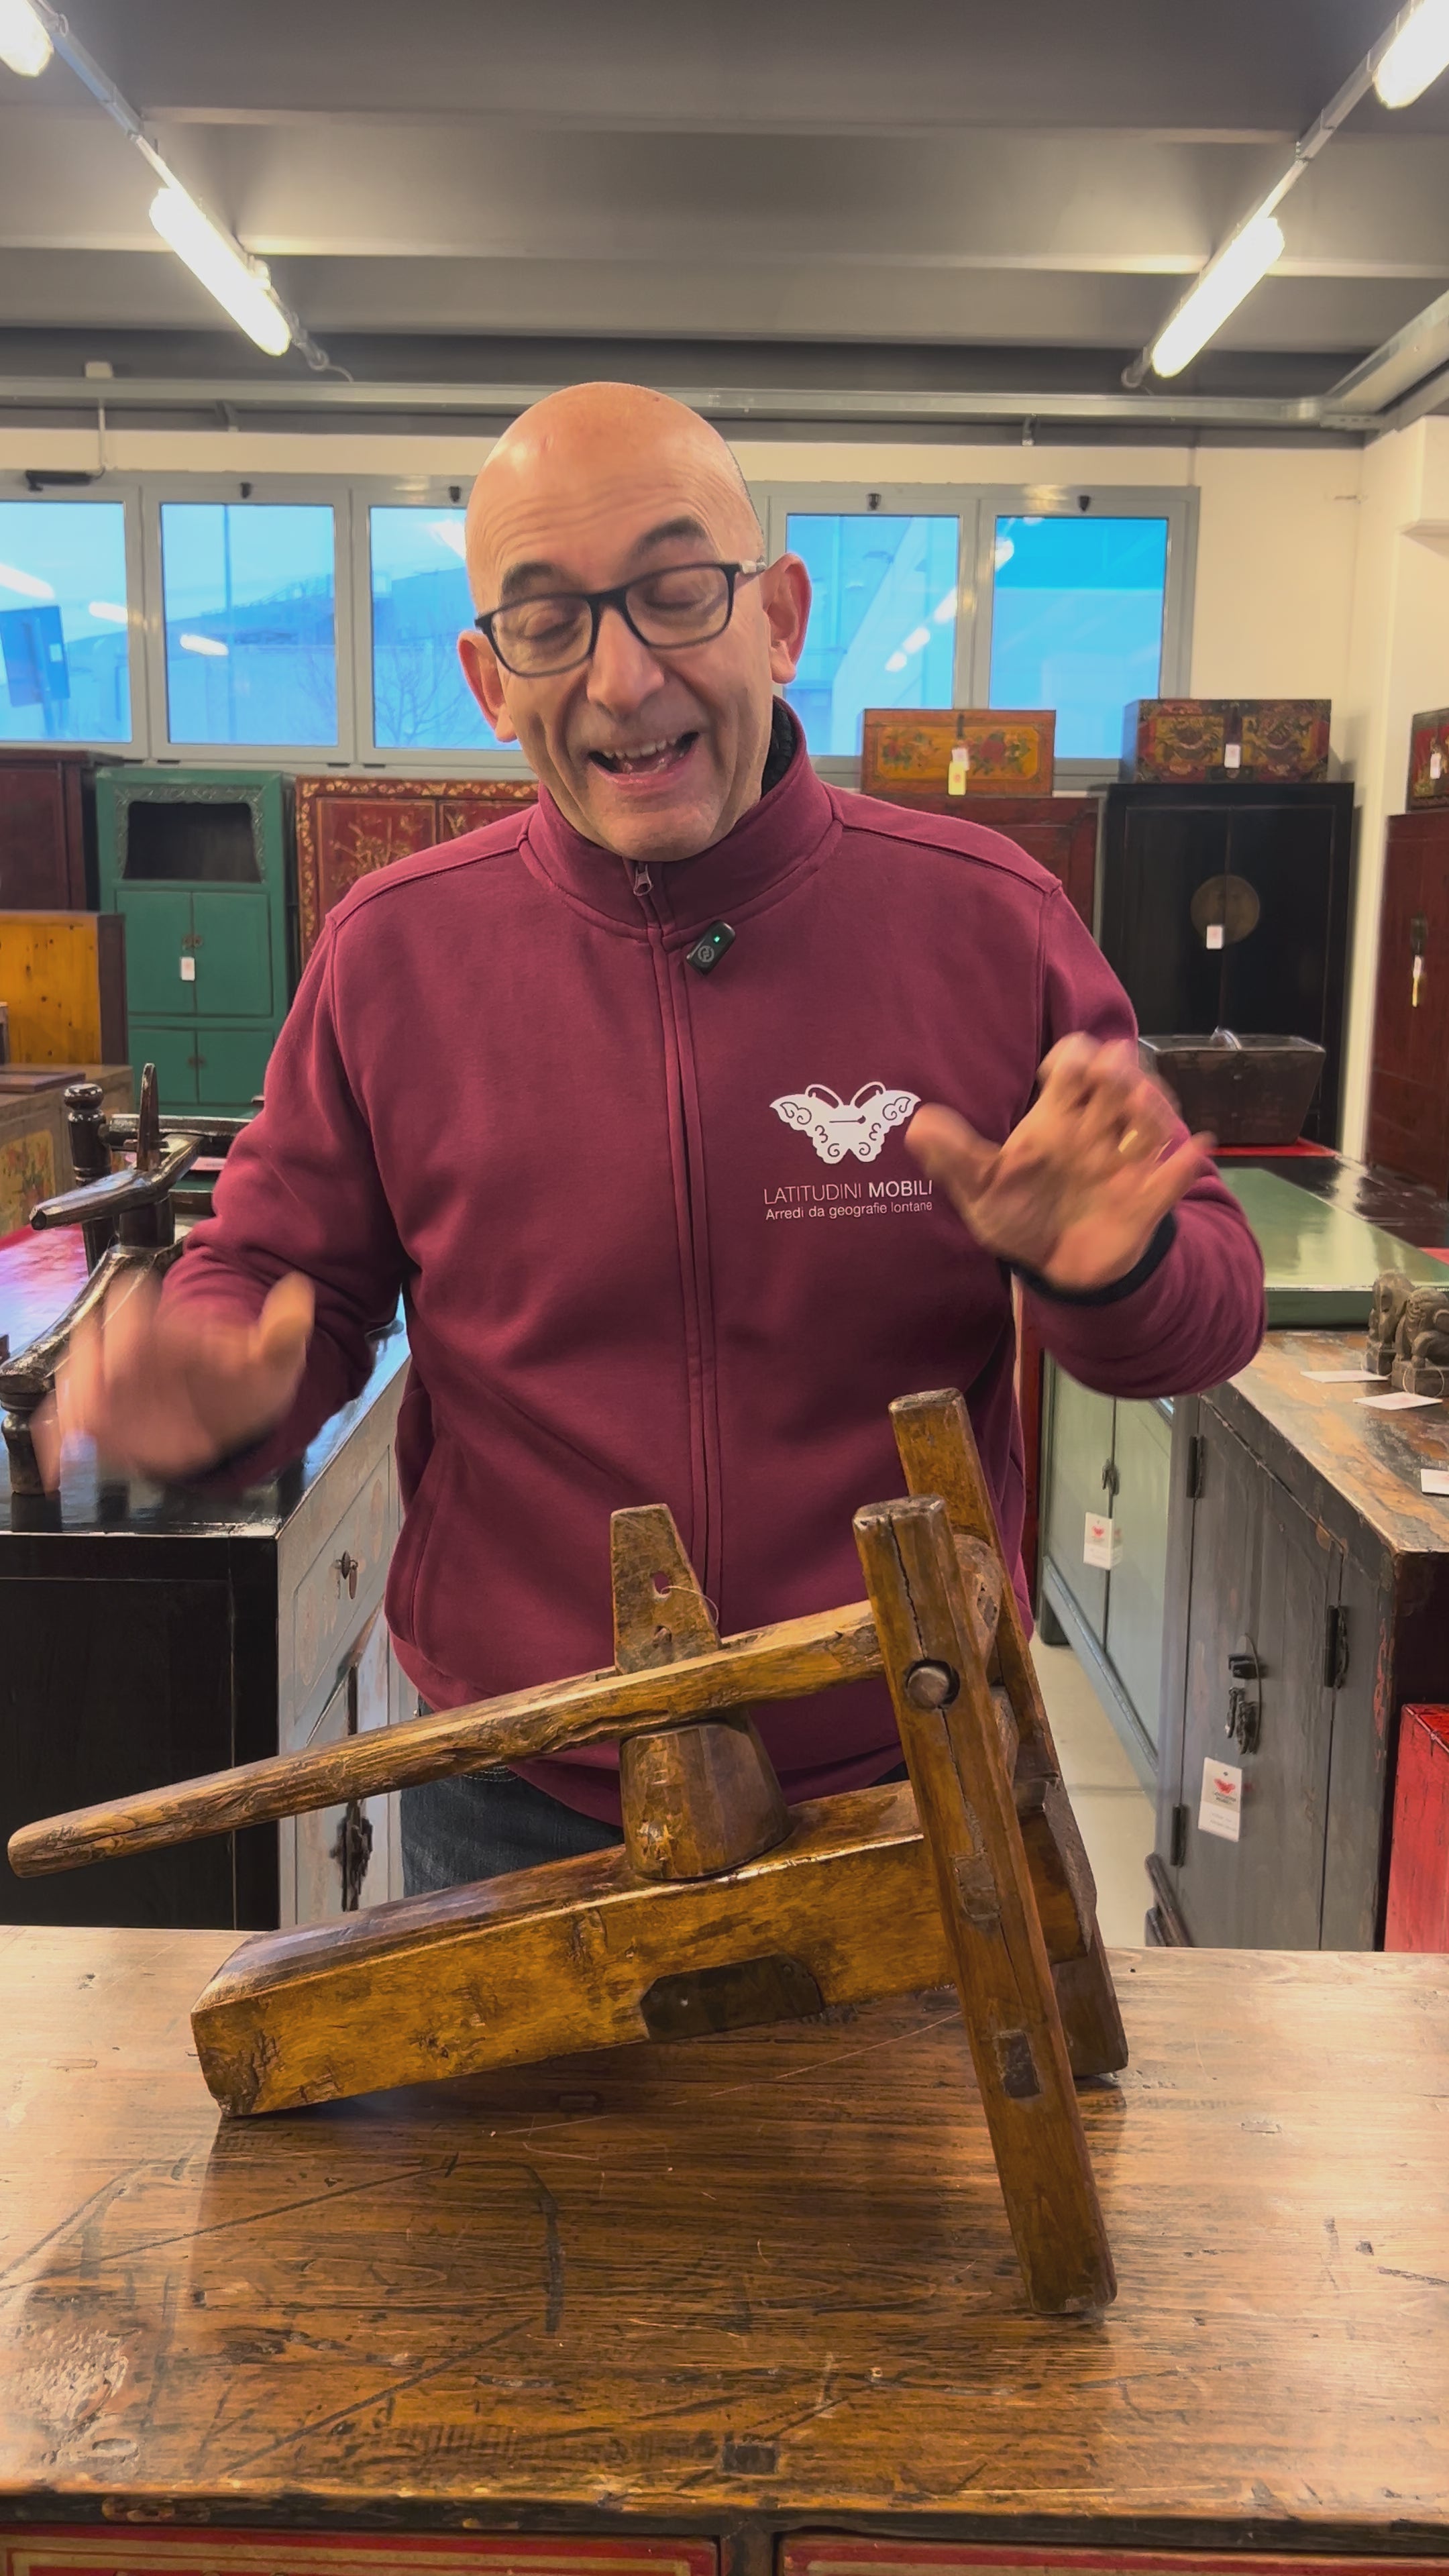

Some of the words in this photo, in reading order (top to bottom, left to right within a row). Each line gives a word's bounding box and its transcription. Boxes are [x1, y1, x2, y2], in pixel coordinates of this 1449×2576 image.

[763, 1183, 861, 1205] LATITUDINI
[868, 1179, 932, 1198] MOBILI
[765, 1206, 804, 1220] Arredi
[808, 1205, 825, 1218] da
[828, 1201, 888, 1219] geografie
[890, 1201, 932, 1213] lontane
